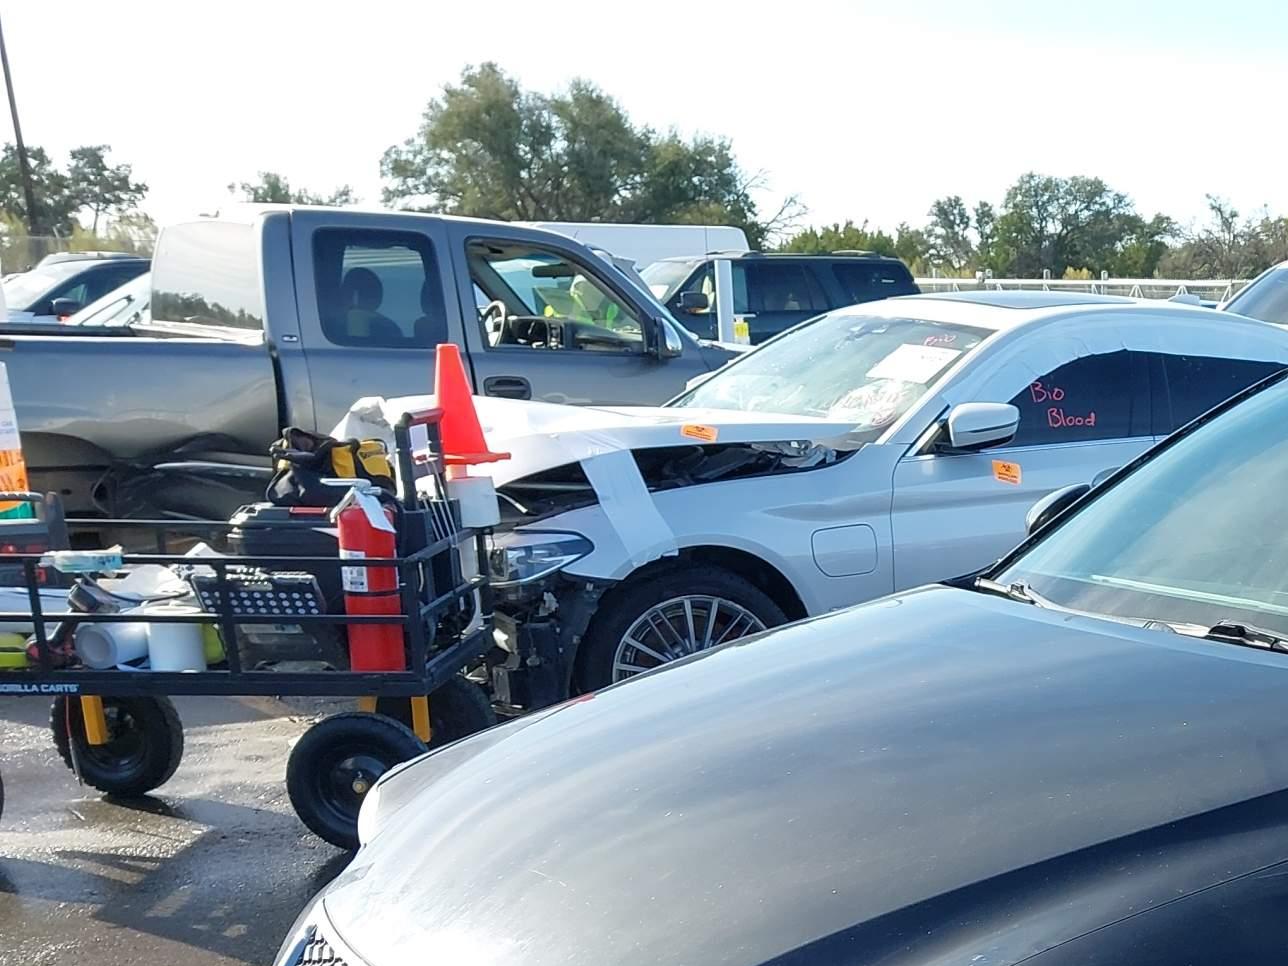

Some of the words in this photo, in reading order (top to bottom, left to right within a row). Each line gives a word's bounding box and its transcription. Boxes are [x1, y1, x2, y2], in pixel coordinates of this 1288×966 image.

[1030, 381, 1065, 403] Bio
[1047, 407, 1096, 428] Blood
[40, 683, 79, 693] CARTS
